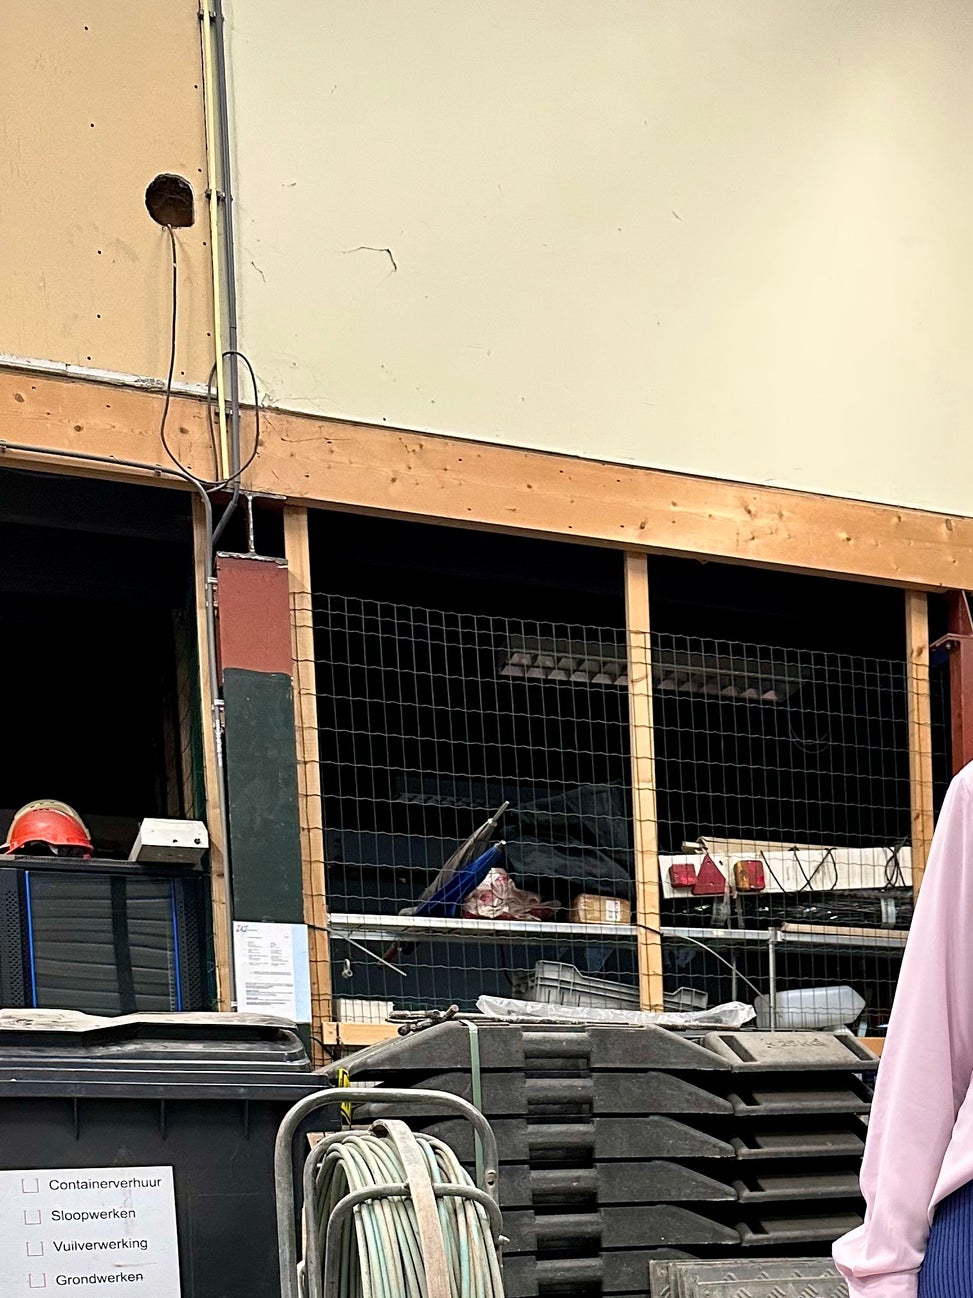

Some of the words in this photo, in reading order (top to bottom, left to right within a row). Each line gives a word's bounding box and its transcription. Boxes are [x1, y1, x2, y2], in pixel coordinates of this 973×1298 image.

[49, 1177, 162, 1191] Containerverhuur
[51, 1208, 136, 1222] Sloopwerken
[53, 1238, 148, 1252] Vuilverwerking
[56, 1272, 144, 1286] Grondwerken
